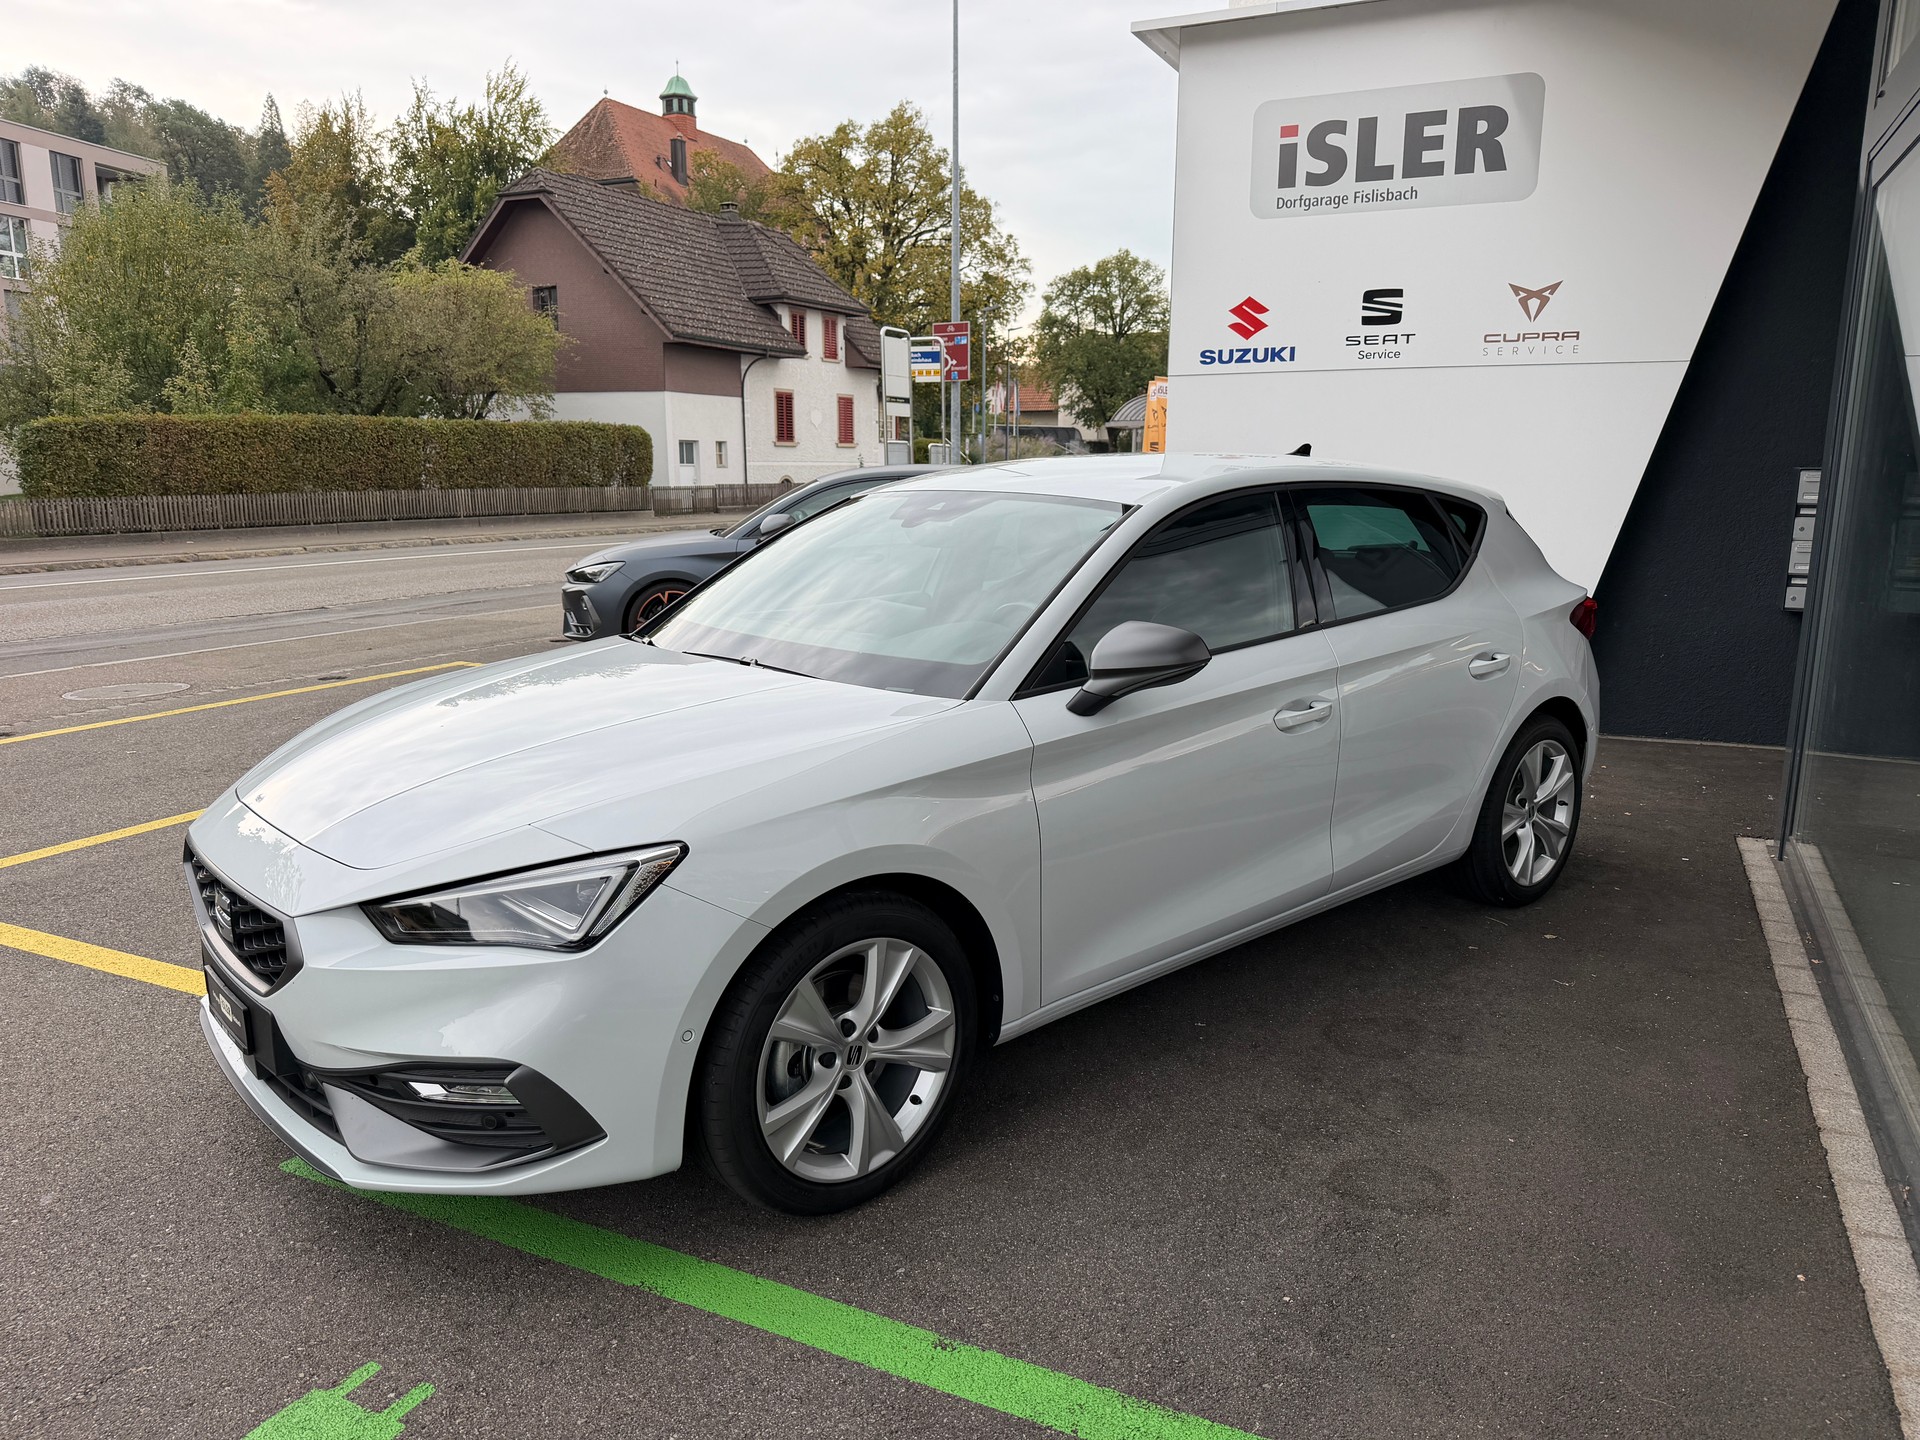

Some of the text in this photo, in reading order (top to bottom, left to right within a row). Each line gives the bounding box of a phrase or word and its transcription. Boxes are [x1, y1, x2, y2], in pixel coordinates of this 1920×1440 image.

[1276, 186, 1418, 212] Dorfgarage Fislisbach
[1345, 333, 1417, 347] SEAT
[1483, 330, 1581, 343] CUPRA
[1199, 346, 1296, 366] SUZUKI
[1357, 349, 1401, 360] Service
[1482, 344, 1580, 357] SERVICE
